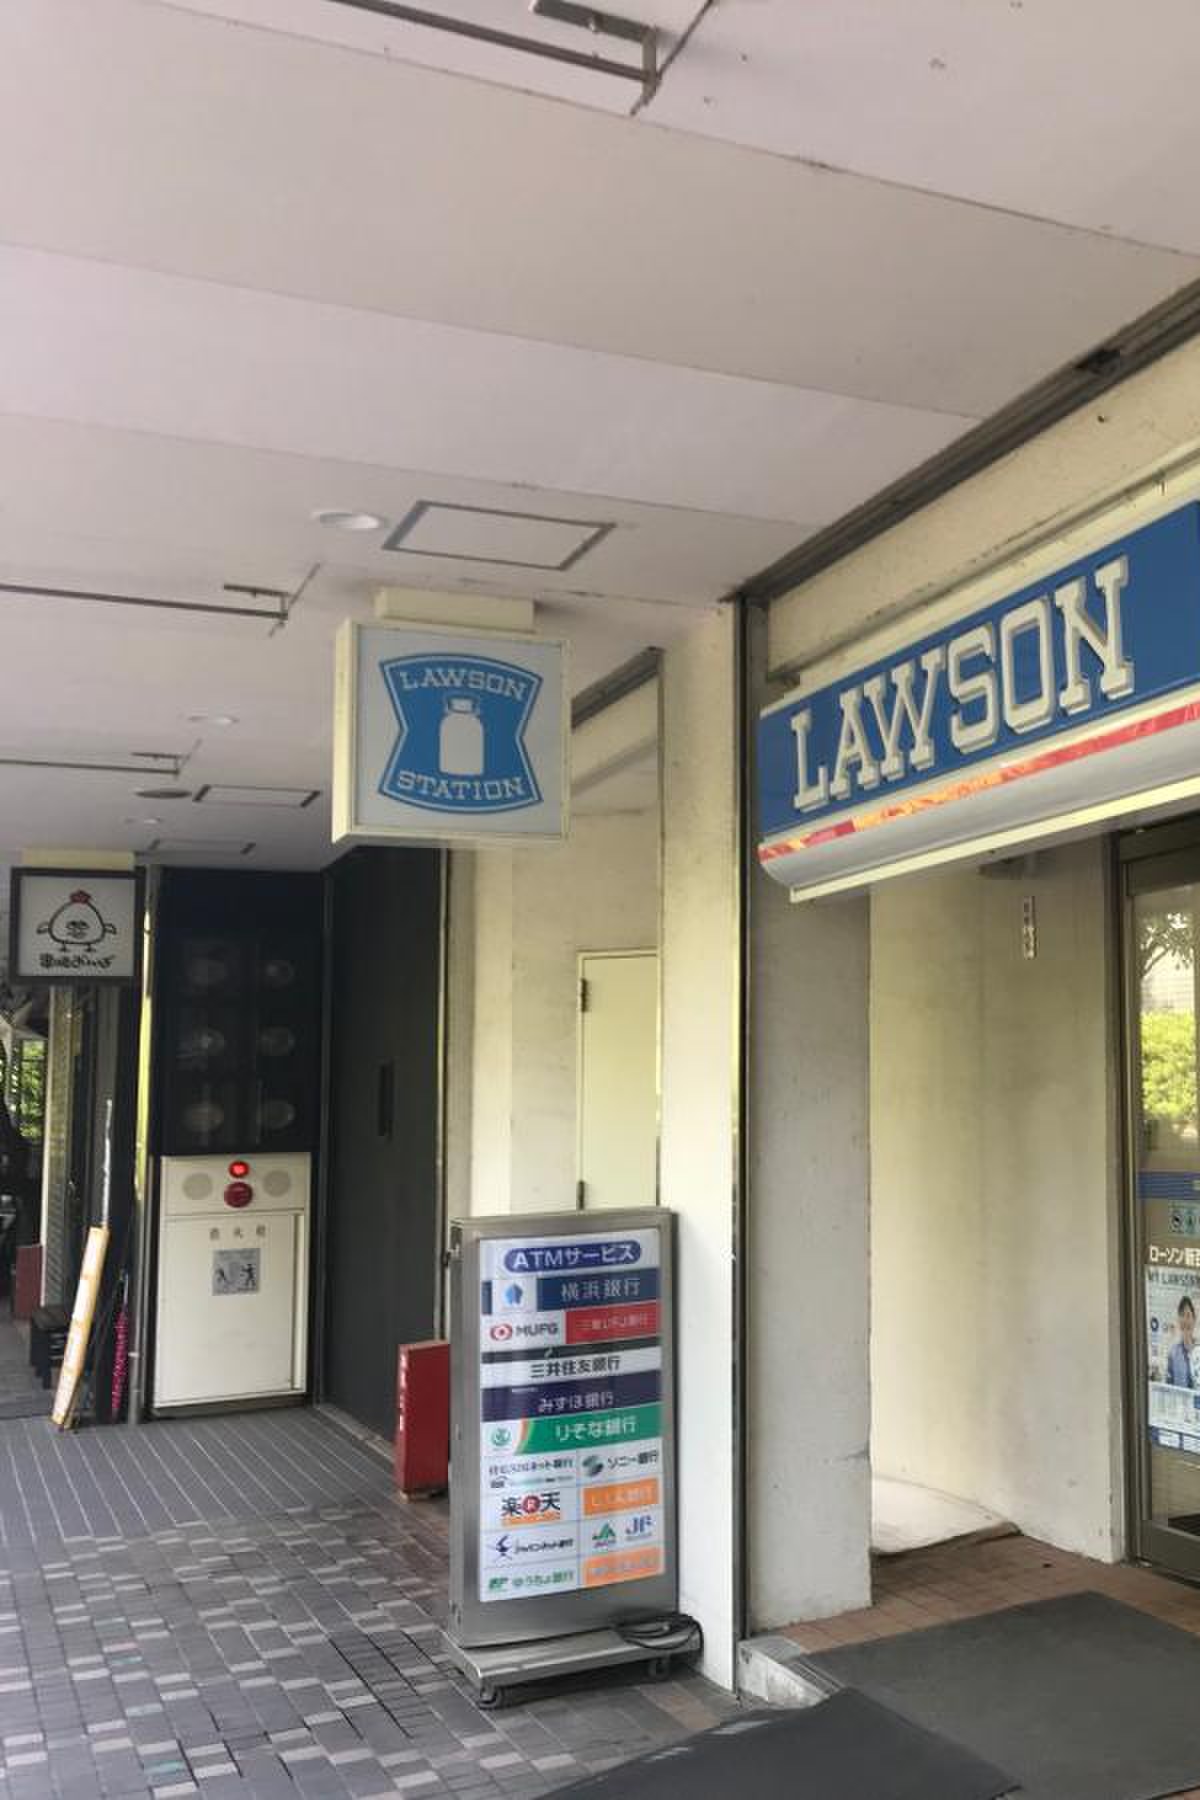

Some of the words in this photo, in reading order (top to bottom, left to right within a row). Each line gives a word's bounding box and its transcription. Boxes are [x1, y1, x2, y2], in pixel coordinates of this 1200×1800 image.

[399, 667, 527, 700] LAWSON
[791, 554, 1135, 813] LAWSON
[397, 770, 526, 800] STATION
[512, 1245, 636, 1268] ATMサービス
[561, 1279, 641, 1301] 横浜銀行
[516, 1323, 559, 1337] MUFG
[531, 1355, 621, 1378] 三井住友銀行
[538, 1392, 614, 1412] みずほ銀行
[555, 1416, 637, 1441] りそな銀行
